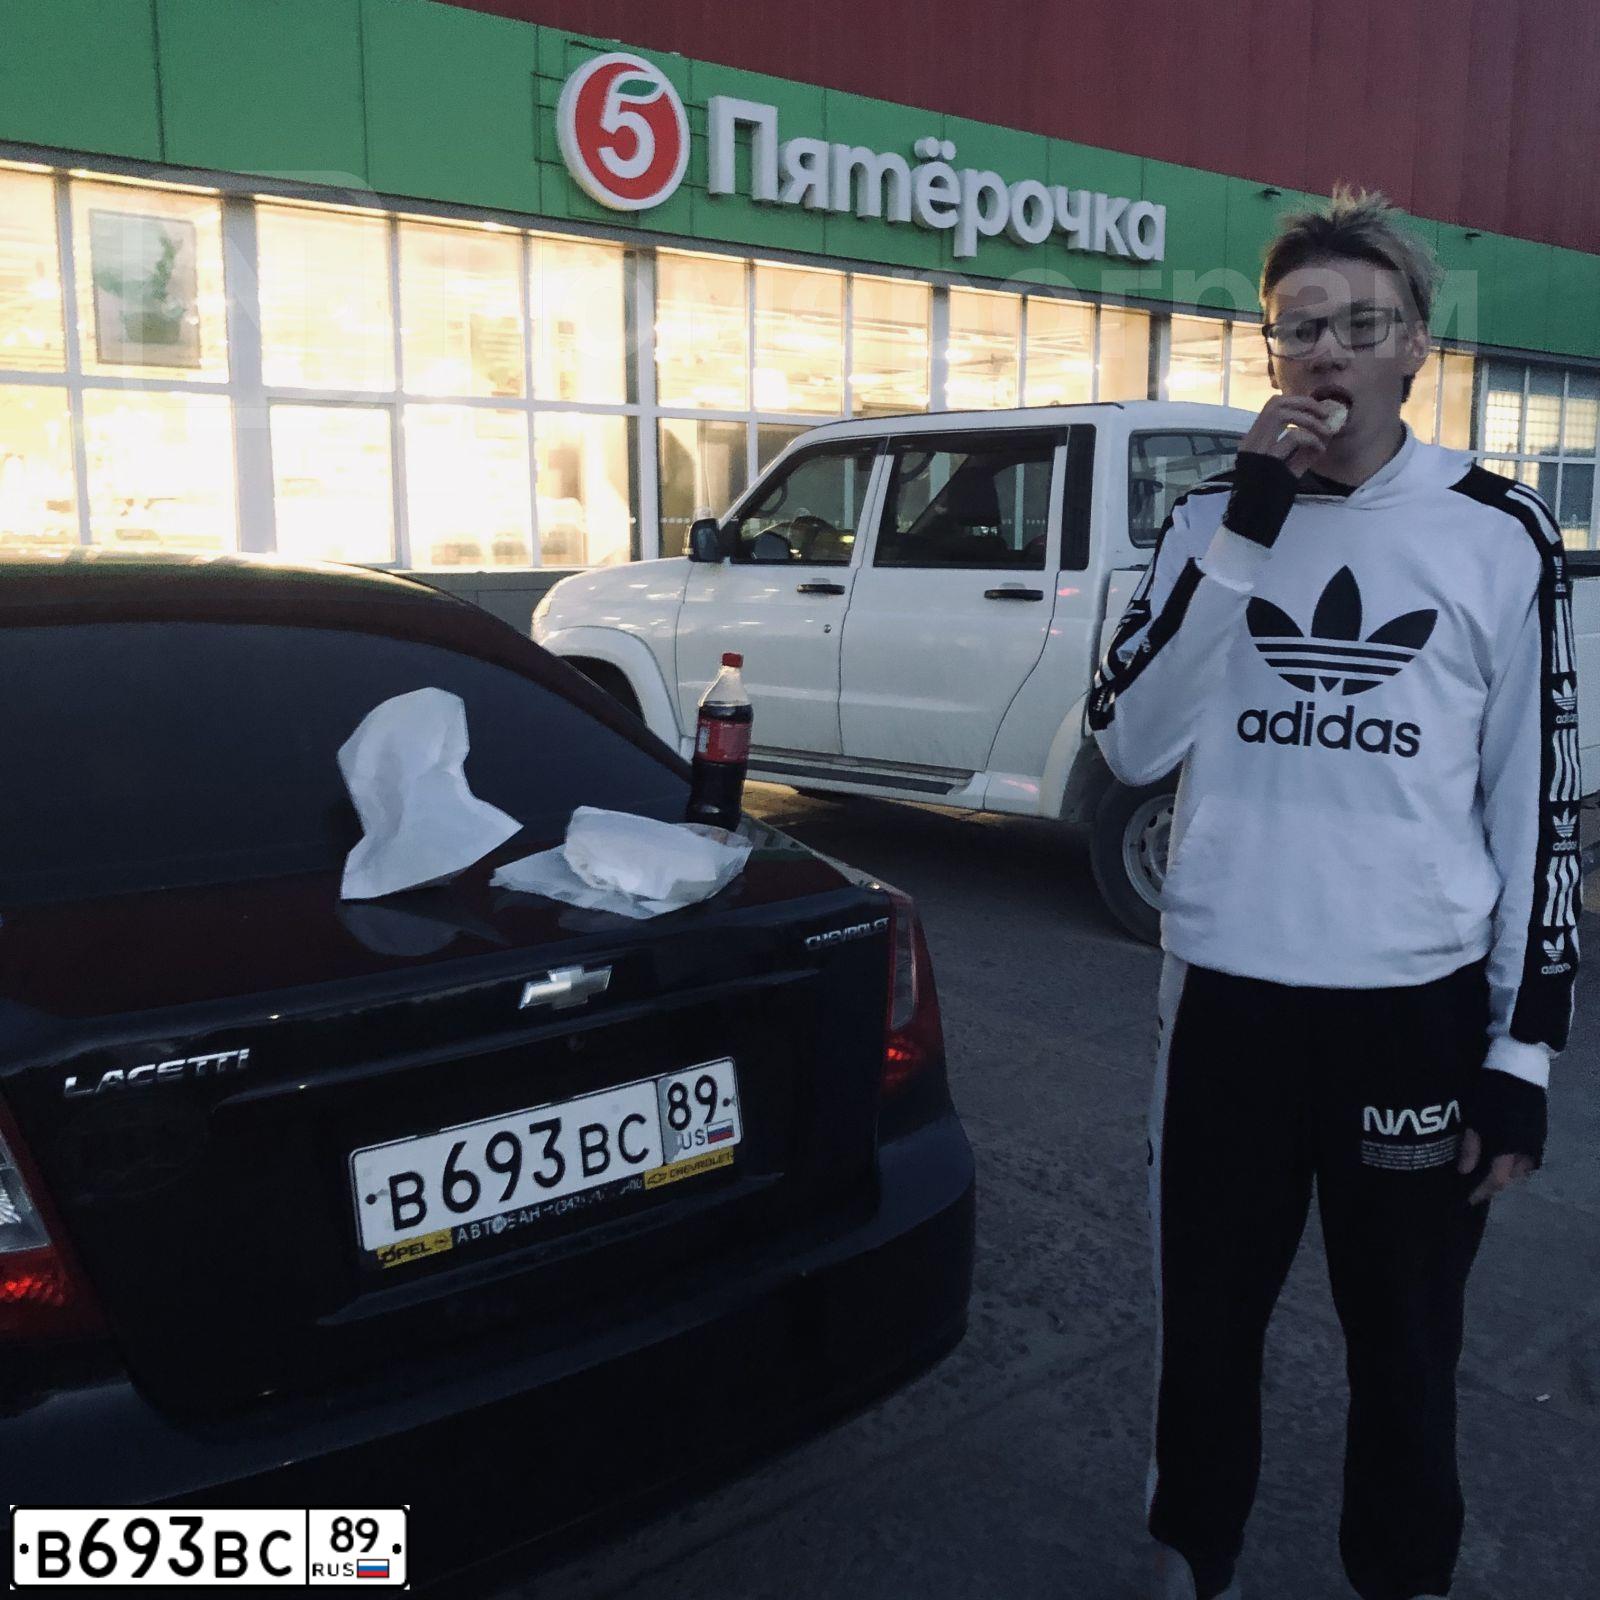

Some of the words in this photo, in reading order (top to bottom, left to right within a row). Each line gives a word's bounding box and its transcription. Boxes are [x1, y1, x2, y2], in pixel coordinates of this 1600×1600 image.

[598, 71, 665, 179] 5
[708, 95, 1167, 262] Пятёрочка
[1237, 701, 1421, 758] adidas
[64, 1048, 250, 1097] LACETTI
[667, 1074, 718, 1131] 89
[1363, 1100, 1461, 1136] NASA
[676, 1129, 706, 1150] US
